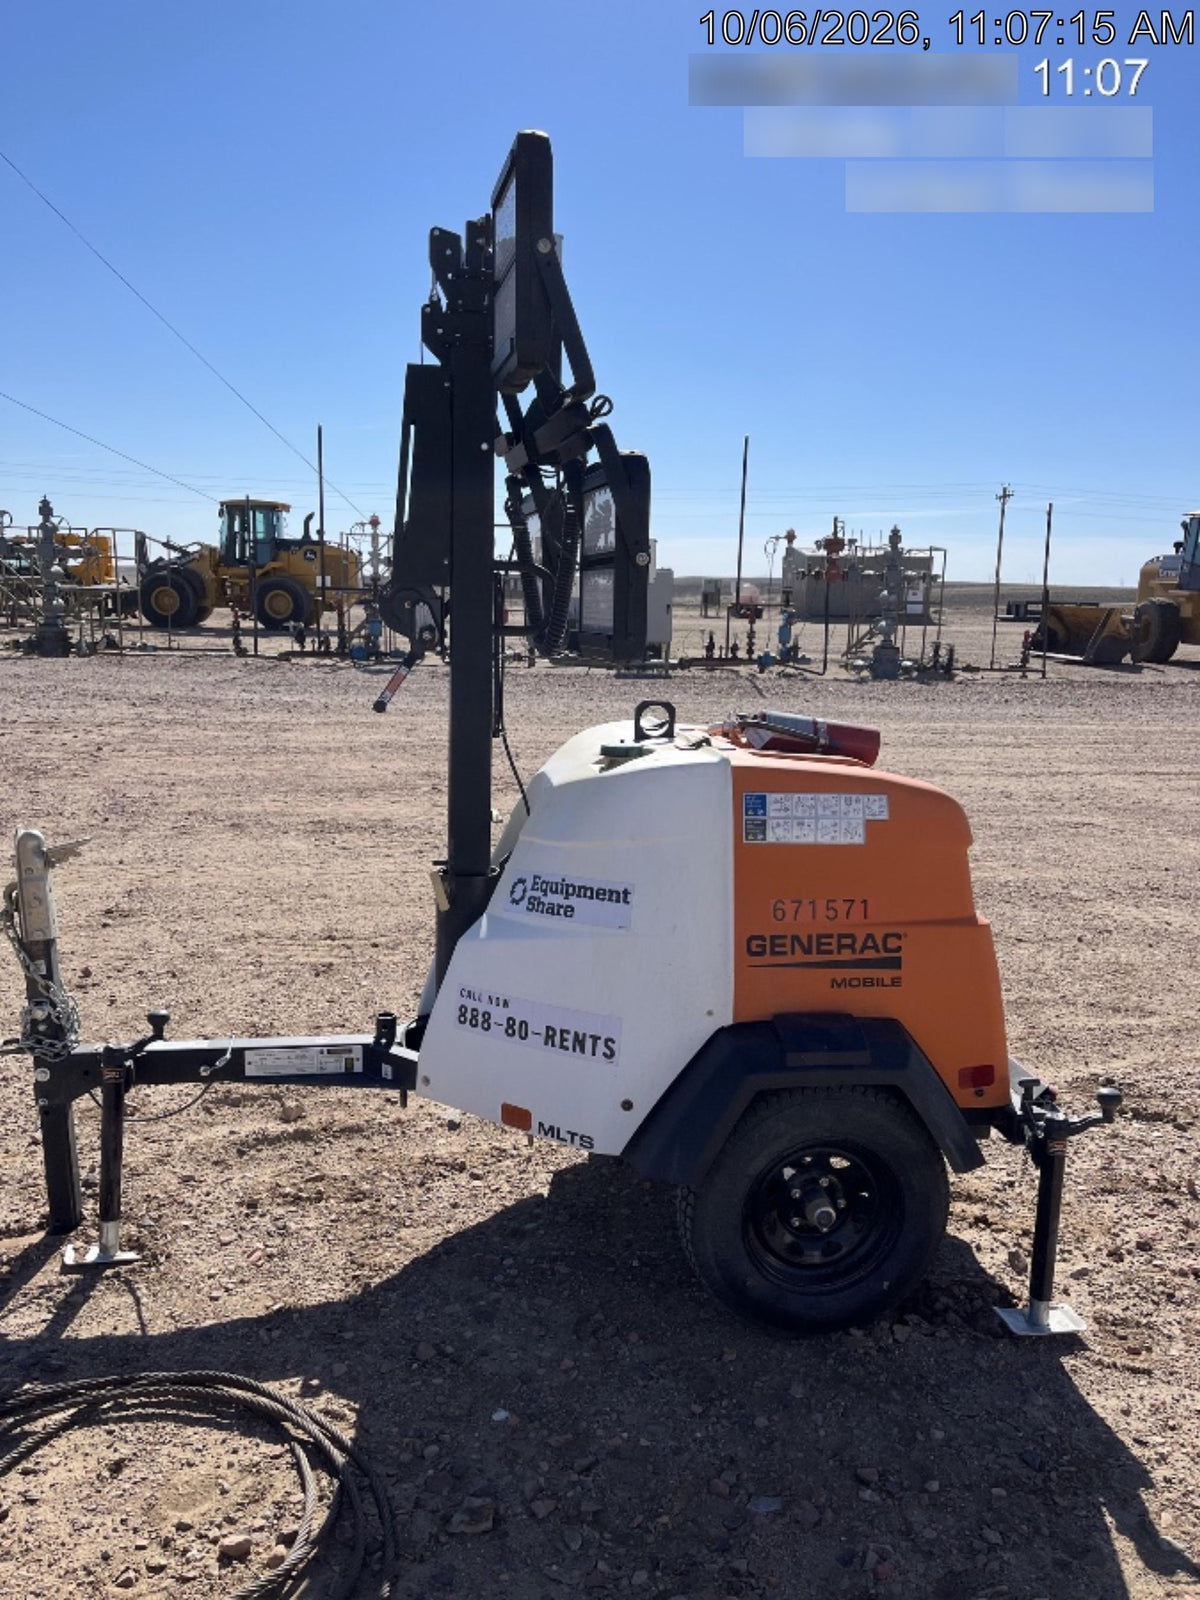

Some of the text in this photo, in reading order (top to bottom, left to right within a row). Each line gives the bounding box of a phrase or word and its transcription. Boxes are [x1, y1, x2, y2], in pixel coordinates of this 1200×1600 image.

[530, 874, 632, 905] Equipment
[525, 896, 576, 919] Share
[772, 899, 870, 922] 671571
[746, 932, 903, 958] GENERAC
[830, 976, 903, 989] MOBILE
[457, 1003, 617, 1061] 888-80-RENTS
[537, 1120, 595, 1150] MLTS
